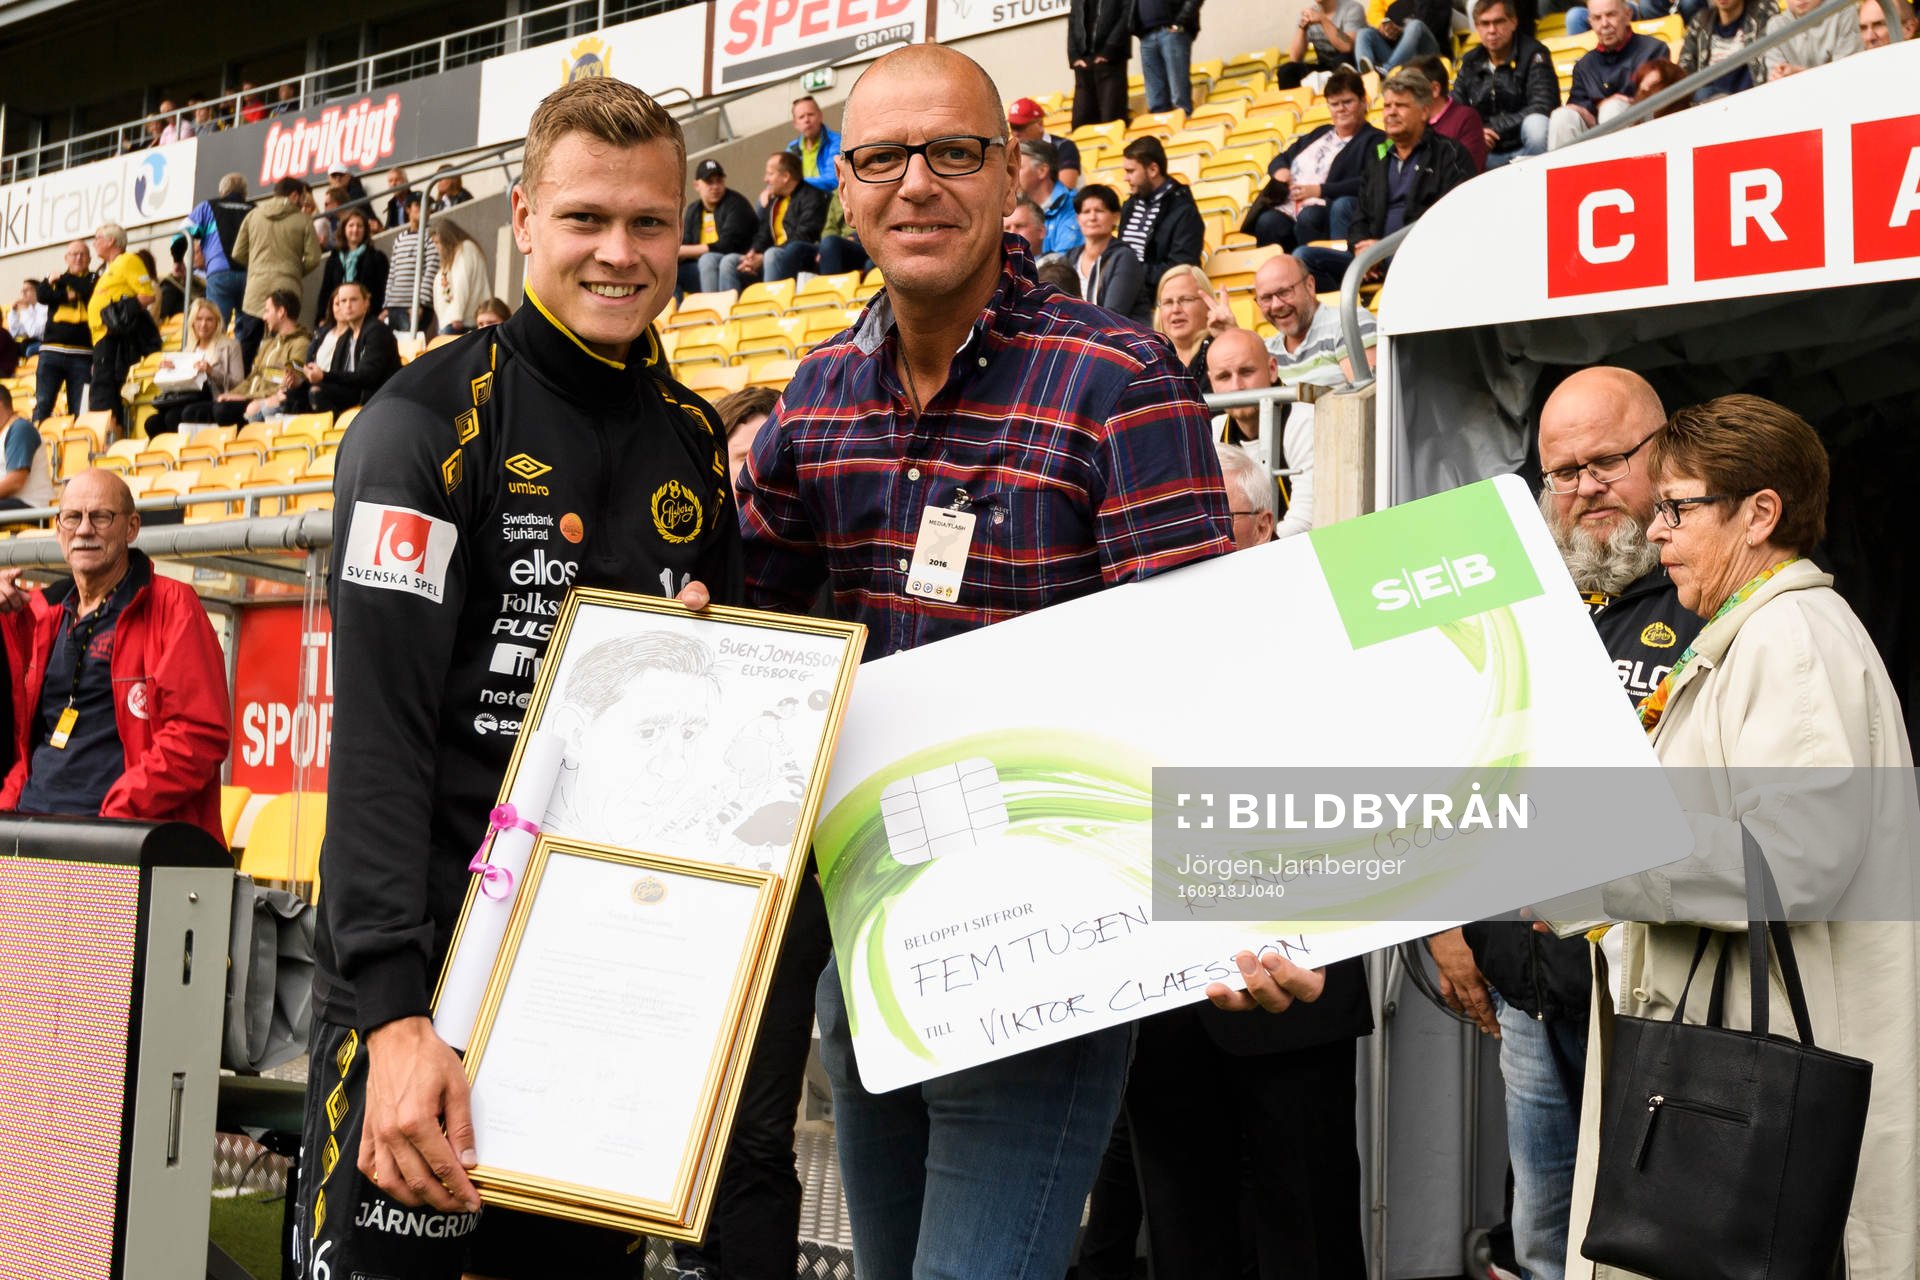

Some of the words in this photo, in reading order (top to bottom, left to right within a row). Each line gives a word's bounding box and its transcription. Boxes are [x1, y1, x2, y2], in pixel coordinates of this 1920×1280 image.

[261, 94, 399, 185] fotriktigt
[0, 186, 32, 249] ki
[38, 160, 128, 240] travel
[508, 481, 550, 497] umbro
[502, 512, 554, 527] Swedbank
[502, 527, 549, 543] Sjuhärad
[509, 548, 579, 586] ellos
[928, 558, 948, 568] 2016
[346, 565, 408, 586] SVENSKA
[414, 577, 440, 597] SPEL
[500, 592, 562, 617] Folks
[719, 637, 760, 658] SVEN
[741, 664, 814, 682] ELFSBORG
[904, 926, 960, 951] BELOPP
[963, 921, 969, 933] I
[972, 902, 1034, 931] SIFFROR
[910, 944, 1004, 997] FEM
[1008, 905, 1149, 963] TUSEN
[925, 1021, 955, 1039] TILL
[980, 994, 1095, 1046] VIKTOR
[355, 1199, 486, 1239] JÄRNGRIN
